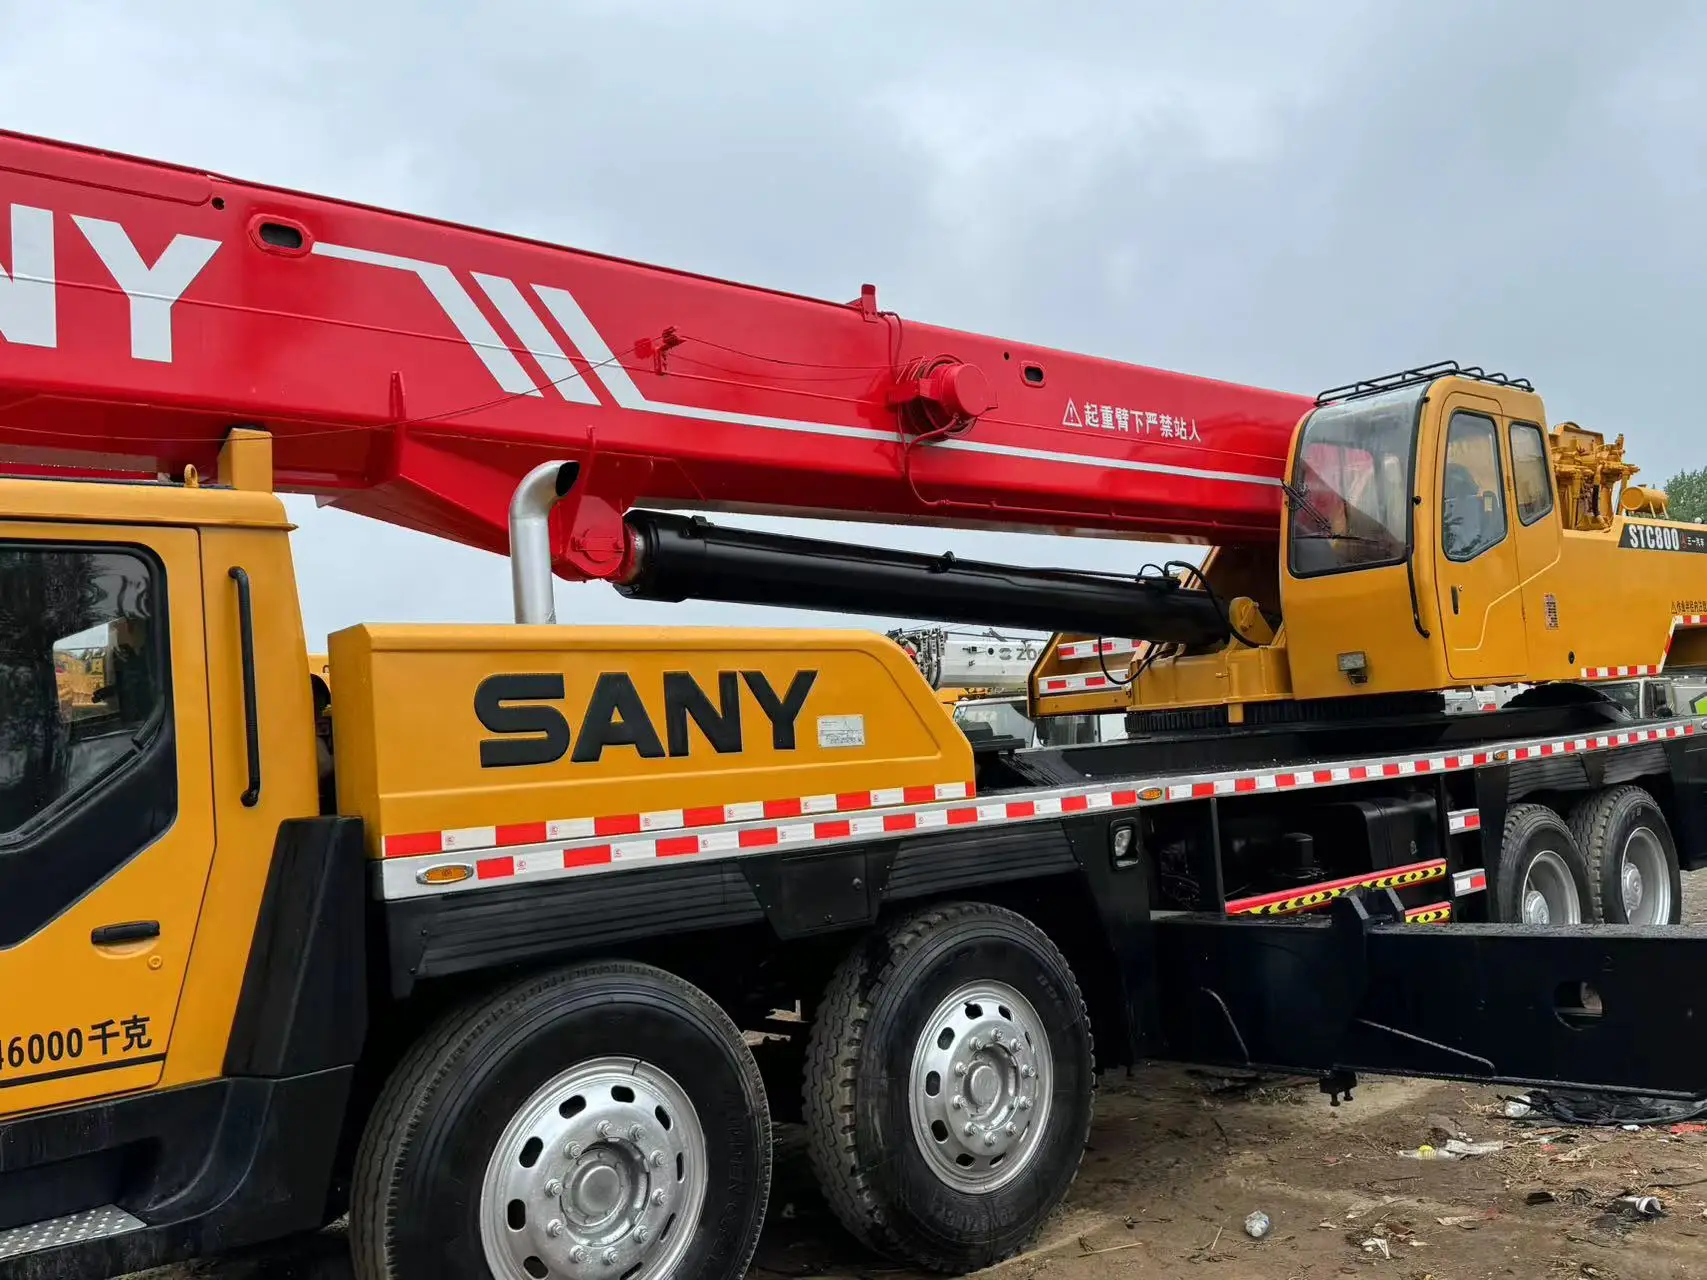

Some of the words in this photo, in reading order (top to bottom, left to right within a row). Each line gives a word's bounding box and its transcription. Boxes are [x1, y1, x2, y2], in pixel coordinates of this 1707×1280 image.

[1083, 402, 1201, 442] 起重臂下严禁站人
[1629, 524, 1680, 551] STC800
[474, 670, 818, 768] SANY
[0, 1027, 83, 1070] 6000
[88, 1014, 153, 1056] 千克
